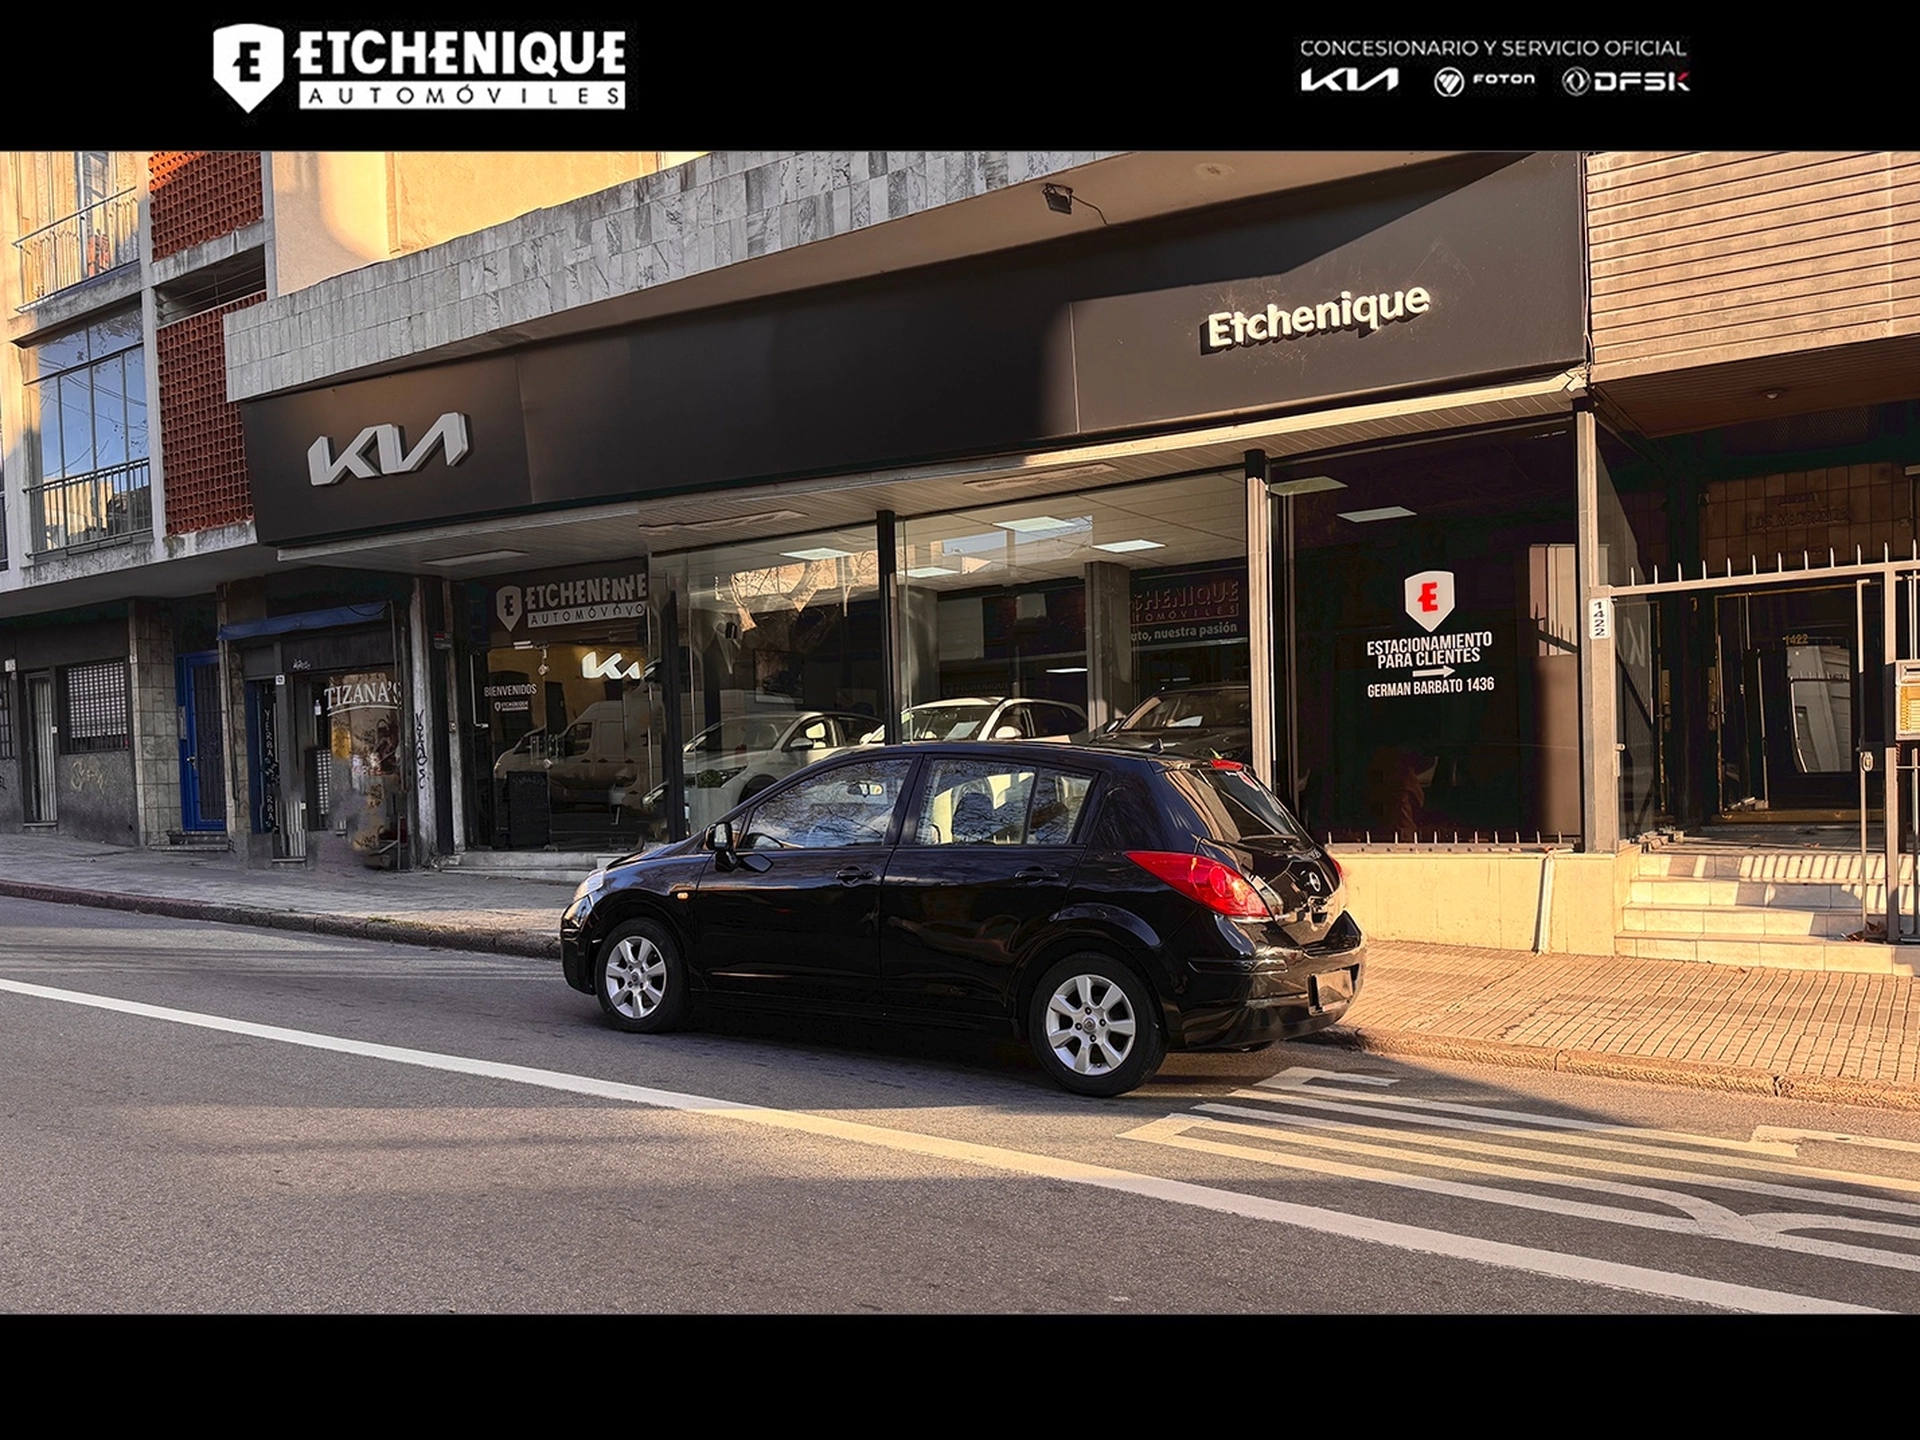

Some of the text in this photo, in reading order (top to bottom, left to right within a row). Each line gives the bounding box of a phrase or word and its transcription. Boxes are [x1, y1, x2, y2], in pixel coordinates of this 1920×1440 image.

[1207, 286, 1431, 348] Etchenique
[306, 411, 471, 487] KIA
[1416, 581, 1438, 613] E
[1154, 626, 1197, 640] nuestra
[1199, 621, 1238, 638] pasión
[1593, 601, 1606, 637] 1422
[1366, 630, 1493, 656] ESTACIONAMIENTO
[1784, 633, 1809, 646] 1422
[1377, 646, 1481, 670] PARA CLIENTES
[323, 680, 403, 713] TIZANA'S
[484, 684, 537, 697] BIENVENIDOS
[1367, 676, 1495, 698] GERMAN BARBATO 1436
